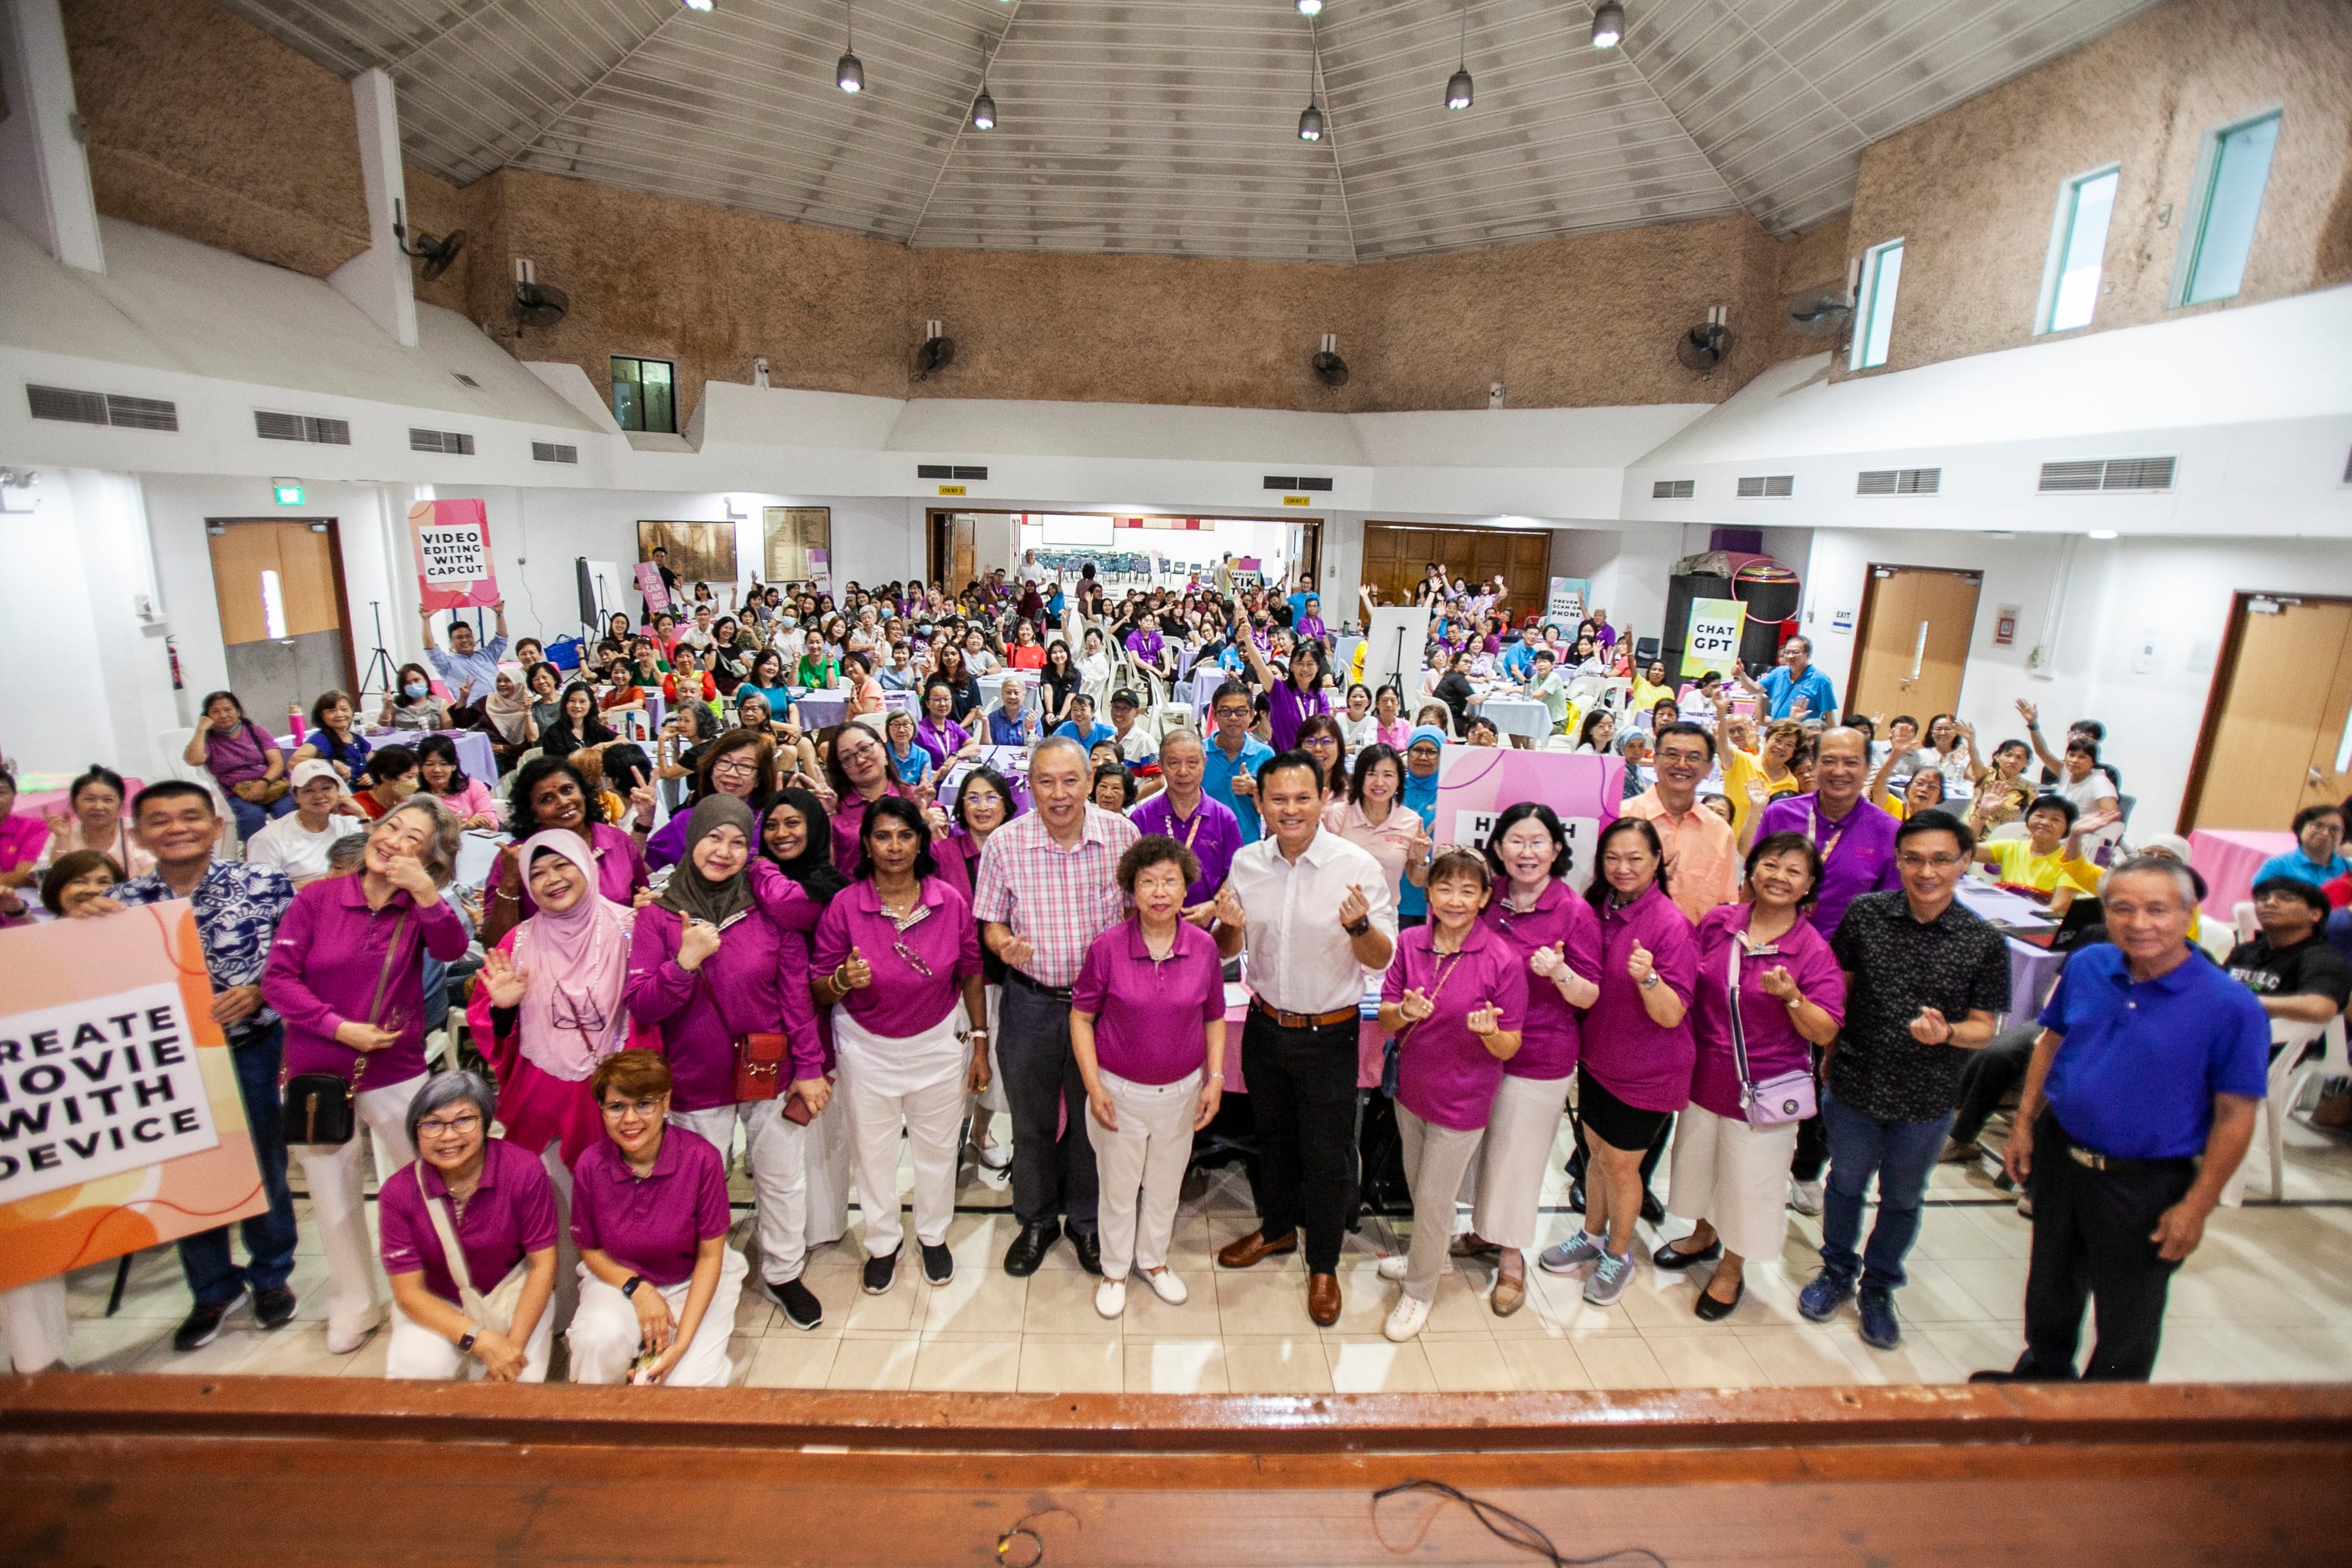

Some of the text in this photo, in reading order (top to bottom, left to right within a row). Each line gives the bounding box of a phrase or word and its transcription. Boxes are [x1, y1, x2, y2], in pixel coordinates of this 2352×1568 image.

[421, 532, 478, 544] VIDEO
[424, 544, 480, 555] EDITING
[433, 555, 474, 564] WITH
[428, 565, 483, 575] CAPCUT
[644, 575, 656, 584] KEEP
[646, 583, 661, 593] CALM
[652, 592, 663, 601] AND
[653, 600, 668, 609] SHOP
[1697, 624, 1735, 635] CHAT
[1695, 637, 1732, 651] GPT
[0, 1006, 176, 1065] REATE
[0, 1035, 185, 1104] OVIE
[0, 1074, 176, 1142] WITH
